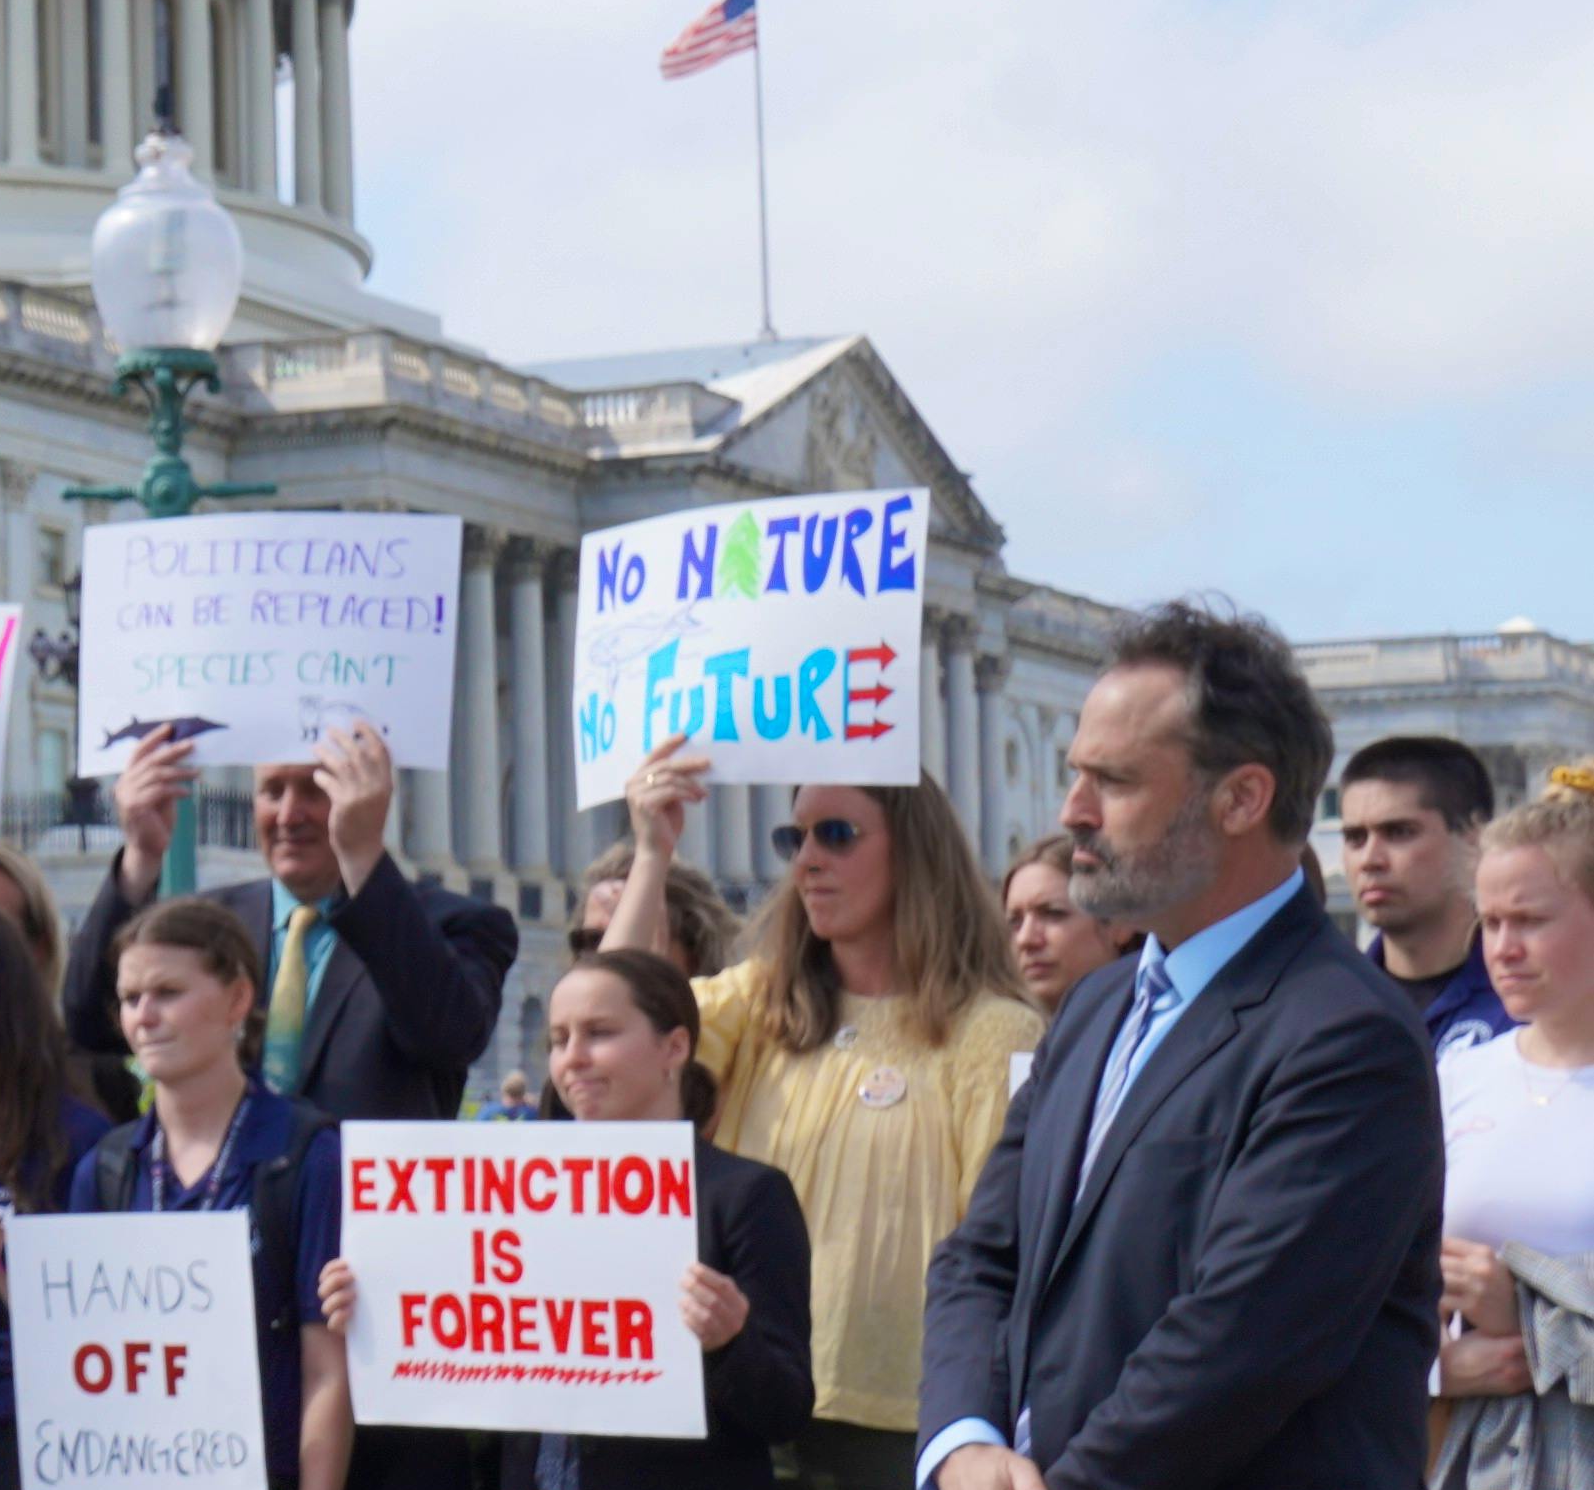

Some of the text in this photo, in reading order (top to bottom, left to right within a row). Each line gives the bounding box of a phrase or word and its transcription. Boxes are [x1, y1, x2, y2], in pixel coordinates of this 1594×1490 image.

[124, 534, 411, 586] POLITICIANS
[597, 539, 646, 614] NO
[116, 589, 447, 635] CAN BE REPLACED!
[130, 649, 281, 695] SPECIES
[579, 636, 898, 762] NO FUTURE
[350, 1155, 692, 1218] EXTINCTION
[471, 1228, 524, 1285] IS
[40, 1258, 215, 1320] HANDS
[398, 1292, 655, 1362] FOREVER
[73, 1341, 189, 1397] OFF
[34, 1418, 249, 1486] ENDANGERED
